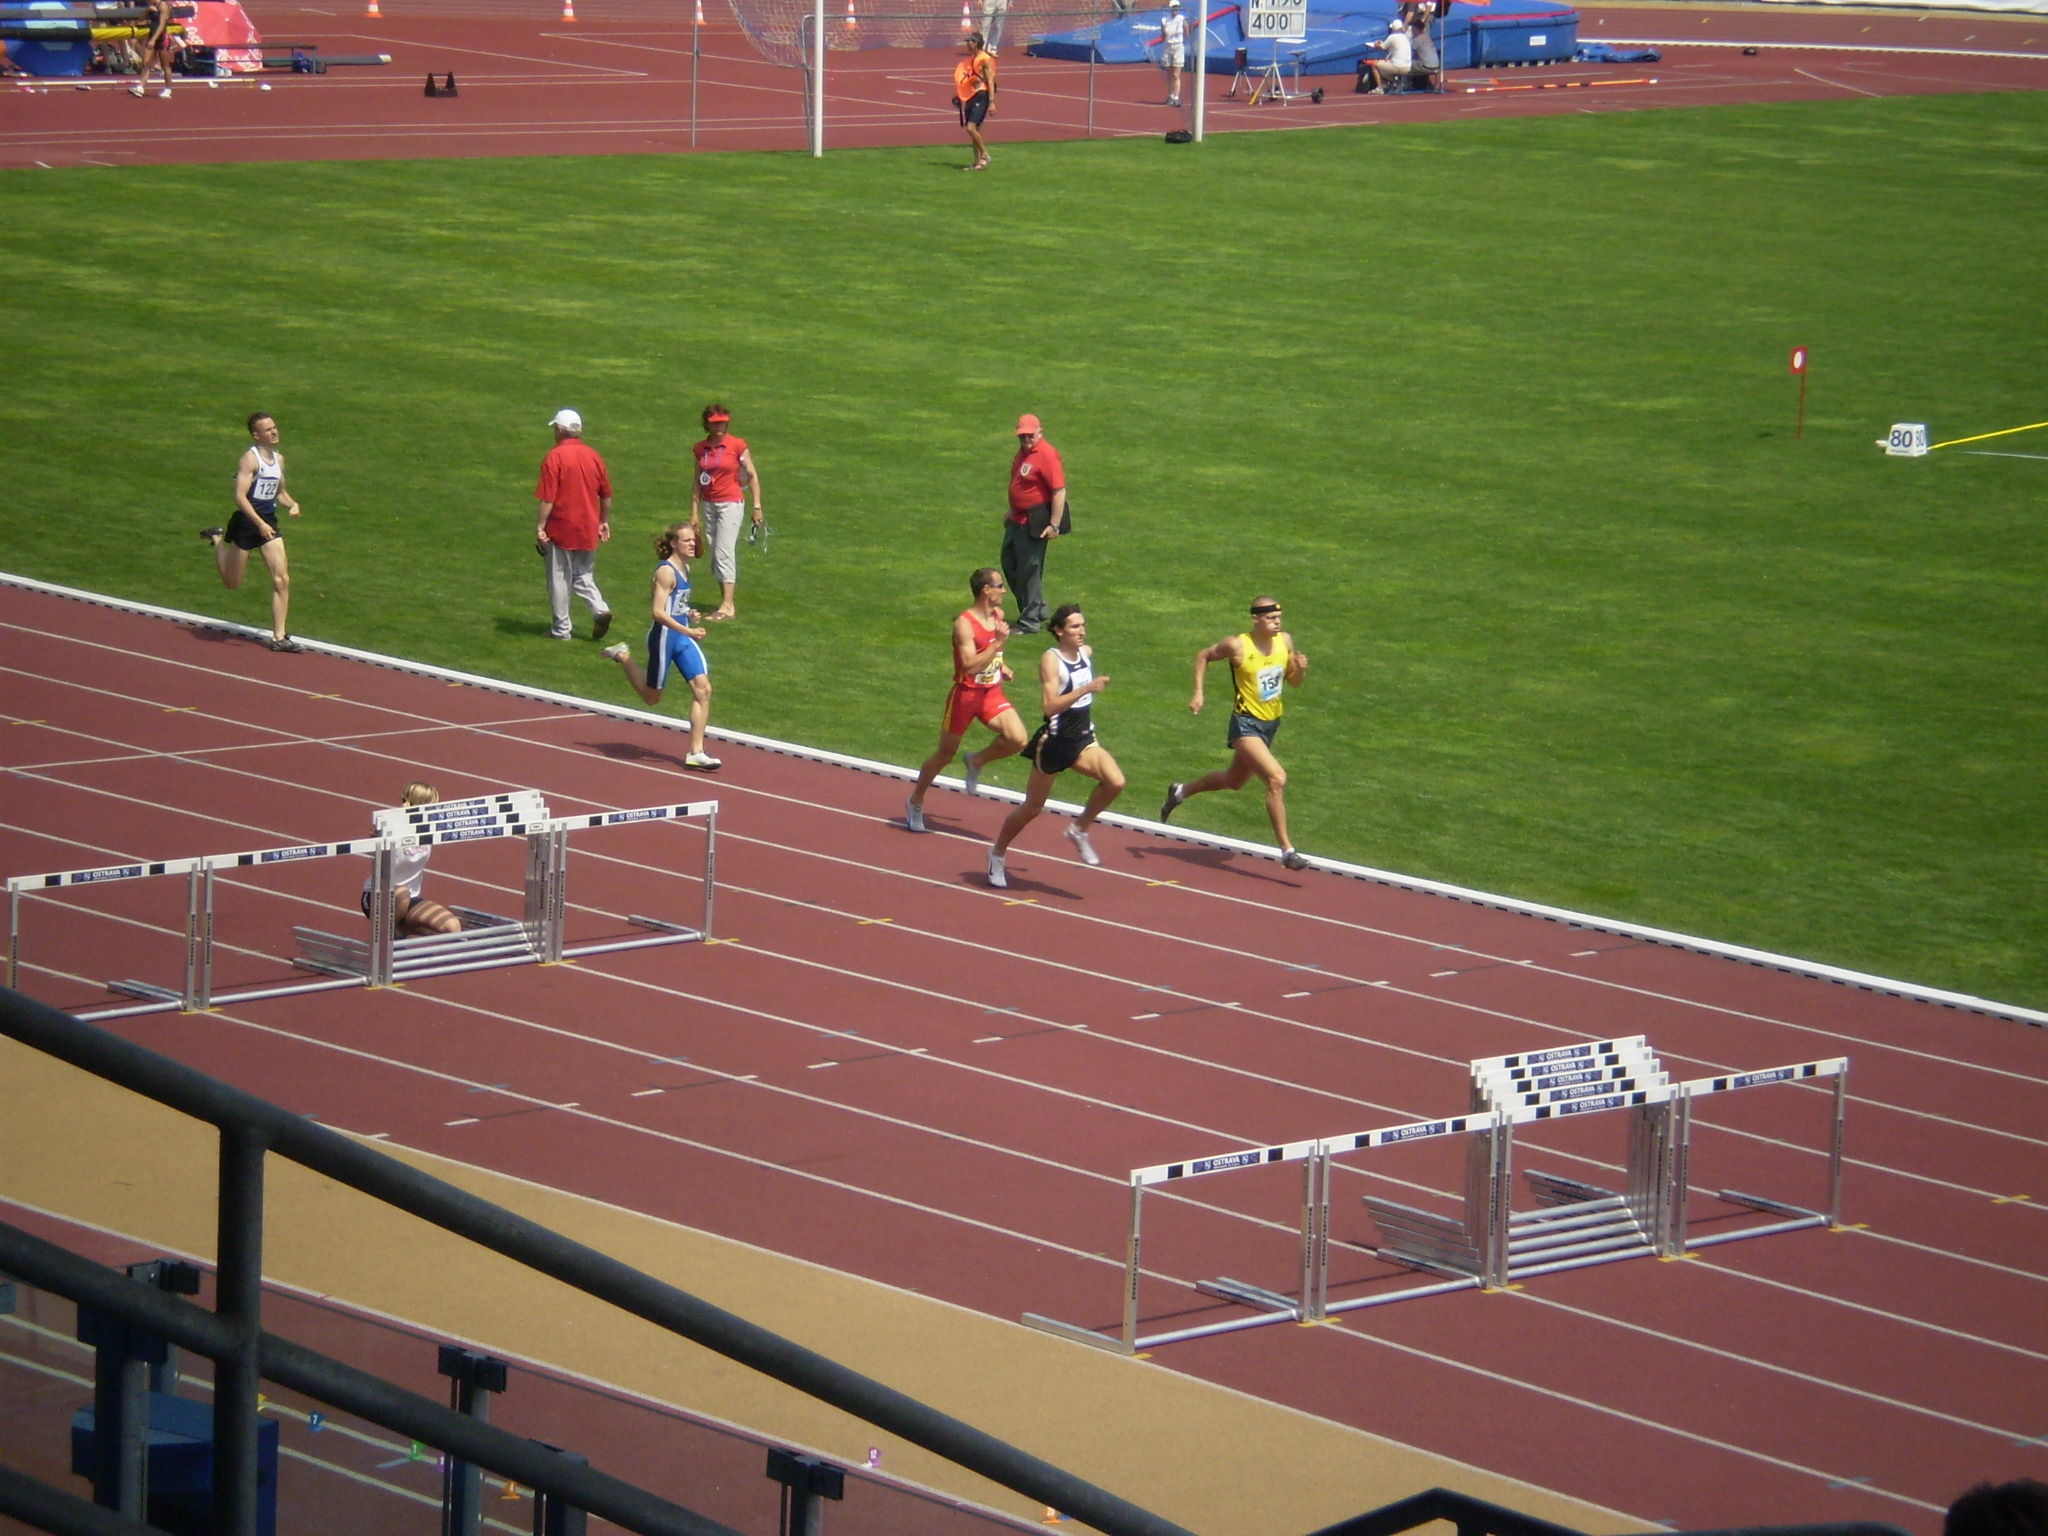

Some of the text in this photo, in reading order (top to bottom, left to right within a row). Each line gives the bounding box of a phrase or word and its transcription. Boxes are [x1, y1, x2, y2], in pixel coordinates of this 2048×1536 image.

[1252, 14, 1288, 30] 400
[1891, 430, 1912, 448] 80
[260, 483, 277, 495] 122
[446, 809, 471, 818] OSTRAVA
[626, 810, 650, 819] OSTRAVA
[454, 819, 479, 828] OSTRAVA
[460, 829, 485, 838] OSTRAVA
[281, 848, 308, 858] OSTRAVA
[92, 869, 121, 878] OSTRAVA
[1546, 1050, 1572, 1060] OSTRAVA
[1550, 1062, 1577, 1072] OSTRAVA
[1557, 1074, 1584, 1084] OSTRAVA
[1752, 1073, 1777, 1082] OSTRAVA
[1569, 1086, 1596, 1096] OSTRAVA
[1580, 1098, 1606, 1109] OSTRAVA
[1400, 1125, 1427, 1137] OSTRAVA
[1213, 1156, 1240, 1167] OSTRAVA
